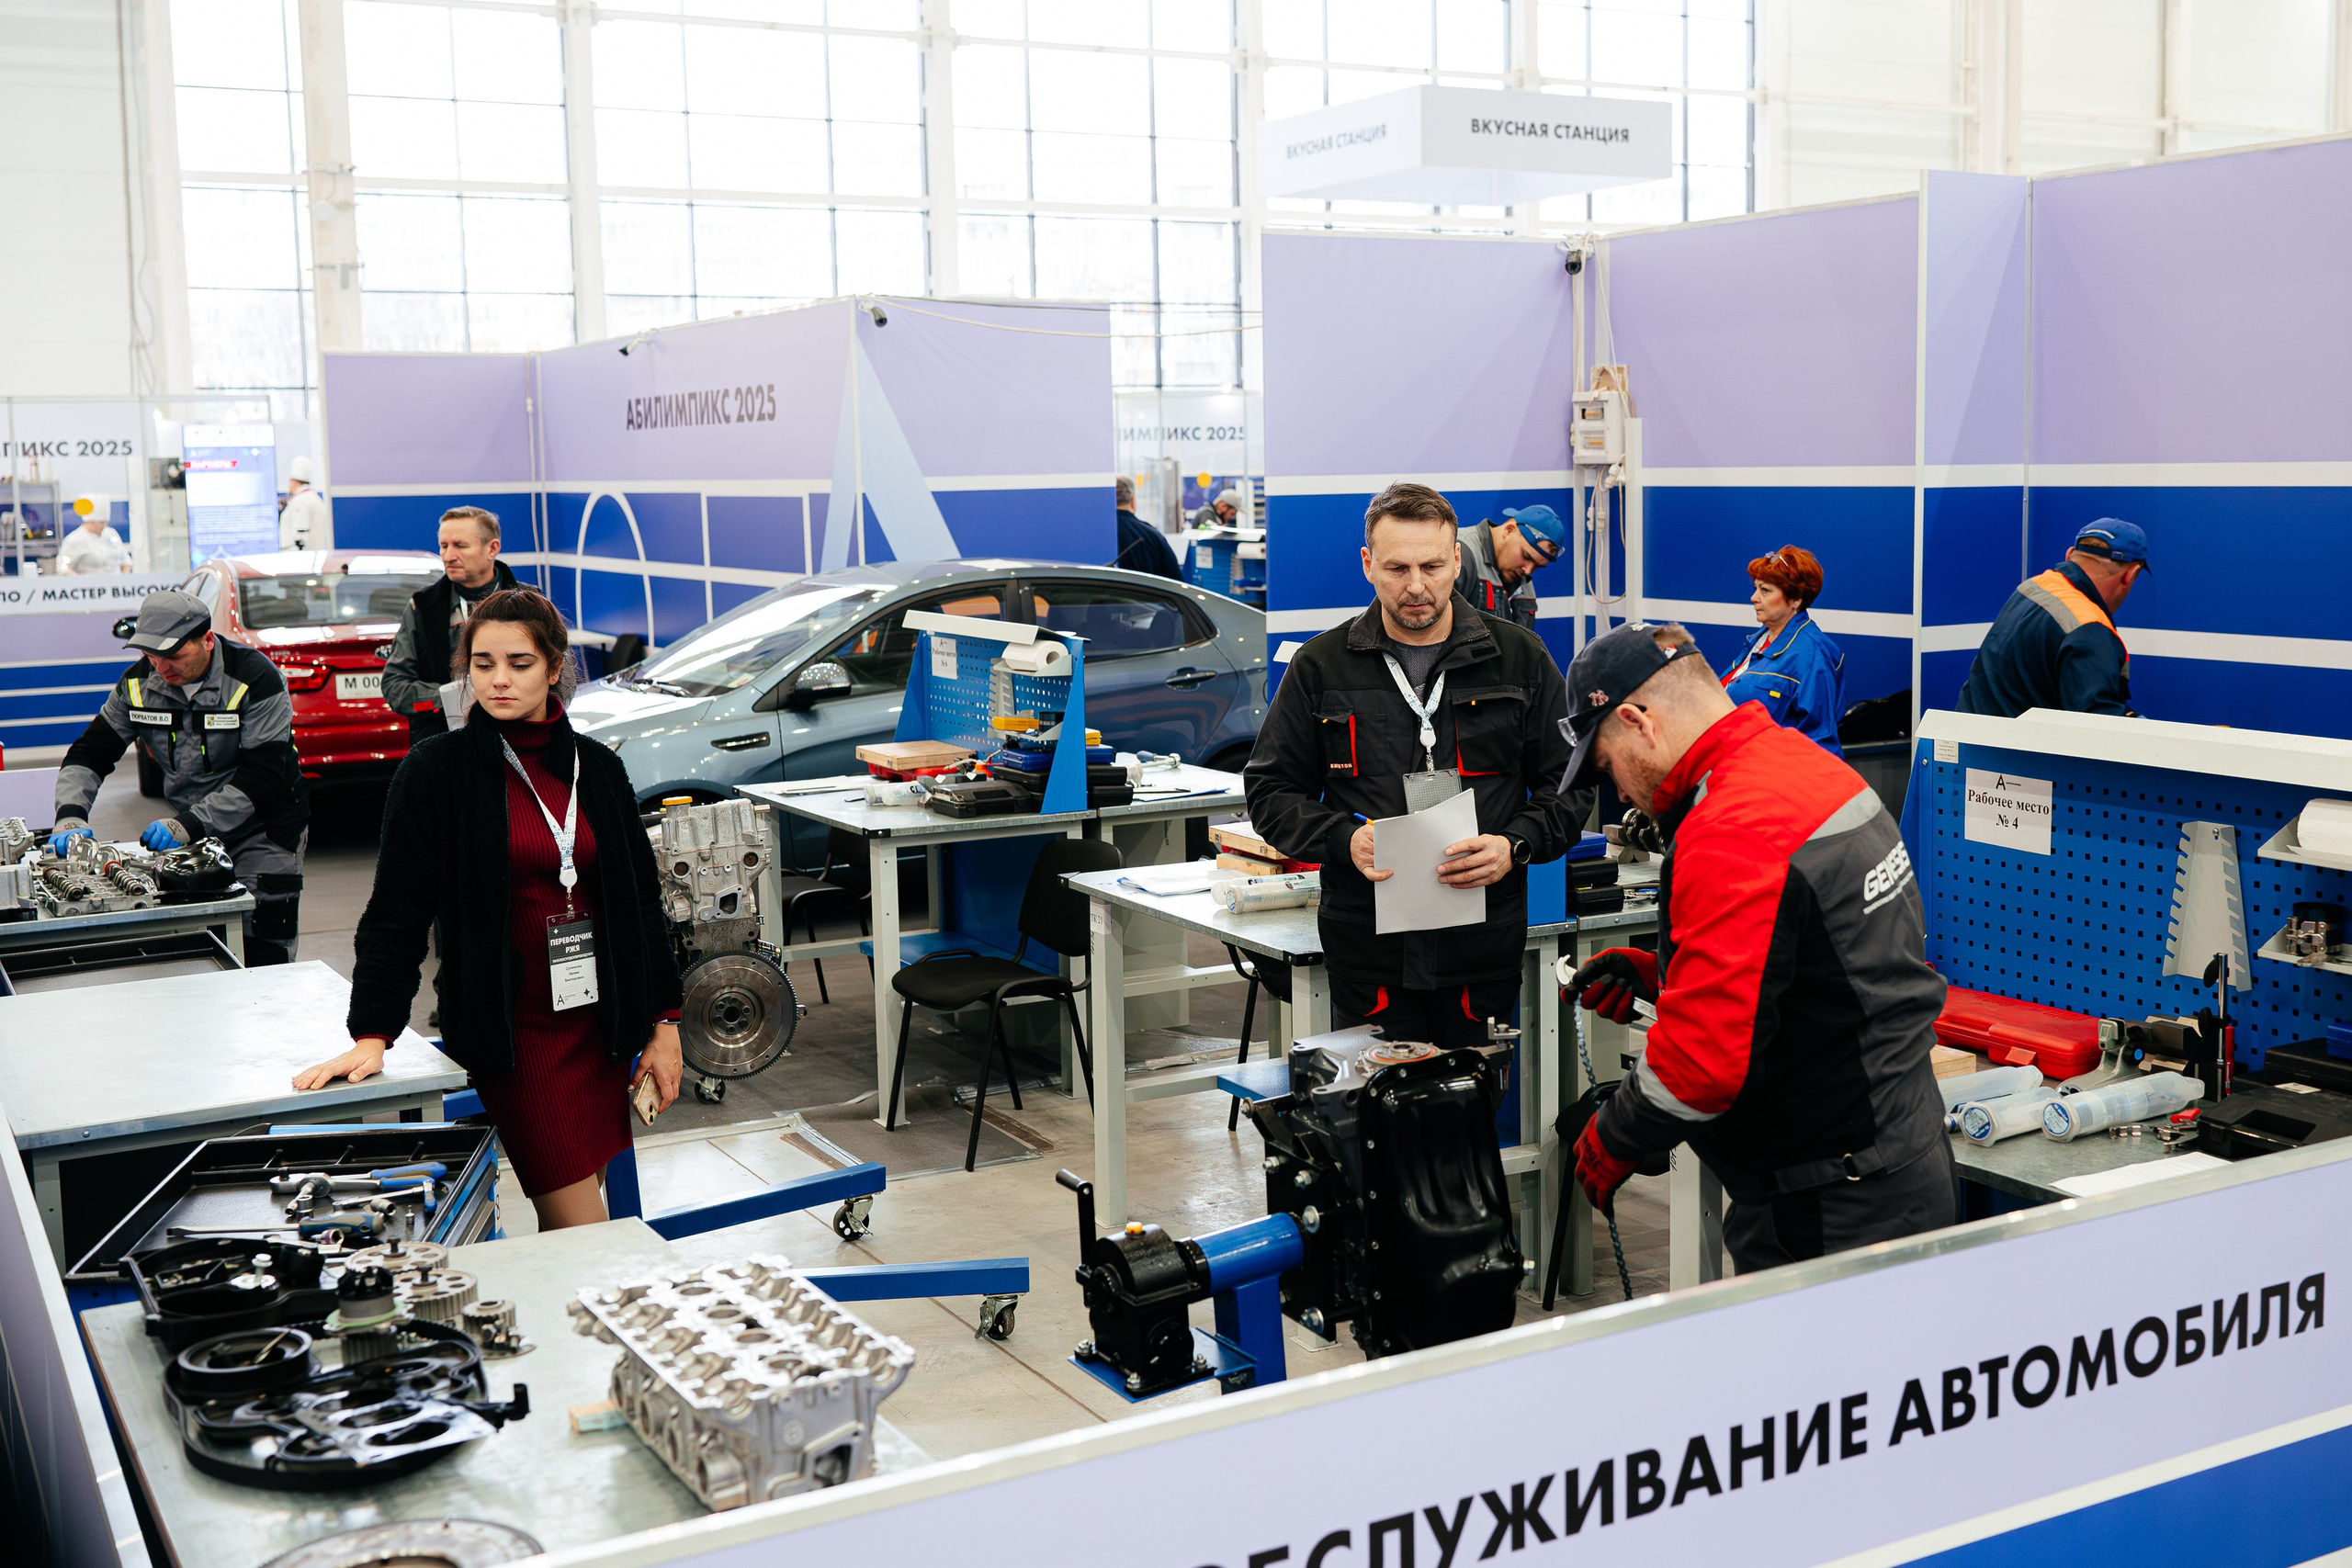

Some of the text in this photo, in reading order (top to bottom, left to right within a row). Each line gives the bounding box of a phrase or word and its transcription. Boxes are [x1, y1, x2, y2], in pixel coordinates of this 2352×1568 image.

[1285, 123, 1386, 160] ВКУСНАЯ СТАНЦИЯ
[1471, 118, 1630, 145] ВКУСНАЯ СТАНЦИЯ
[627, 384, 776, 431] АБИЛИМПИКС 2025
[0, 440, 133, 457] ПИКС 2025
[42, 587, 107, 603] МАСТЕР
[1967, 789, 2050, 816] Рабочее место
[1996, 813, 2019, 829] № 4
[550, 931, 594, 947] ПЕРЕВОДЧИК
[565, 944, 581, 954] РЖЯ
[1193, 1270, 2327, 1568] СЛУЖИВАНИЕ АВТОМОБИЛЯ
